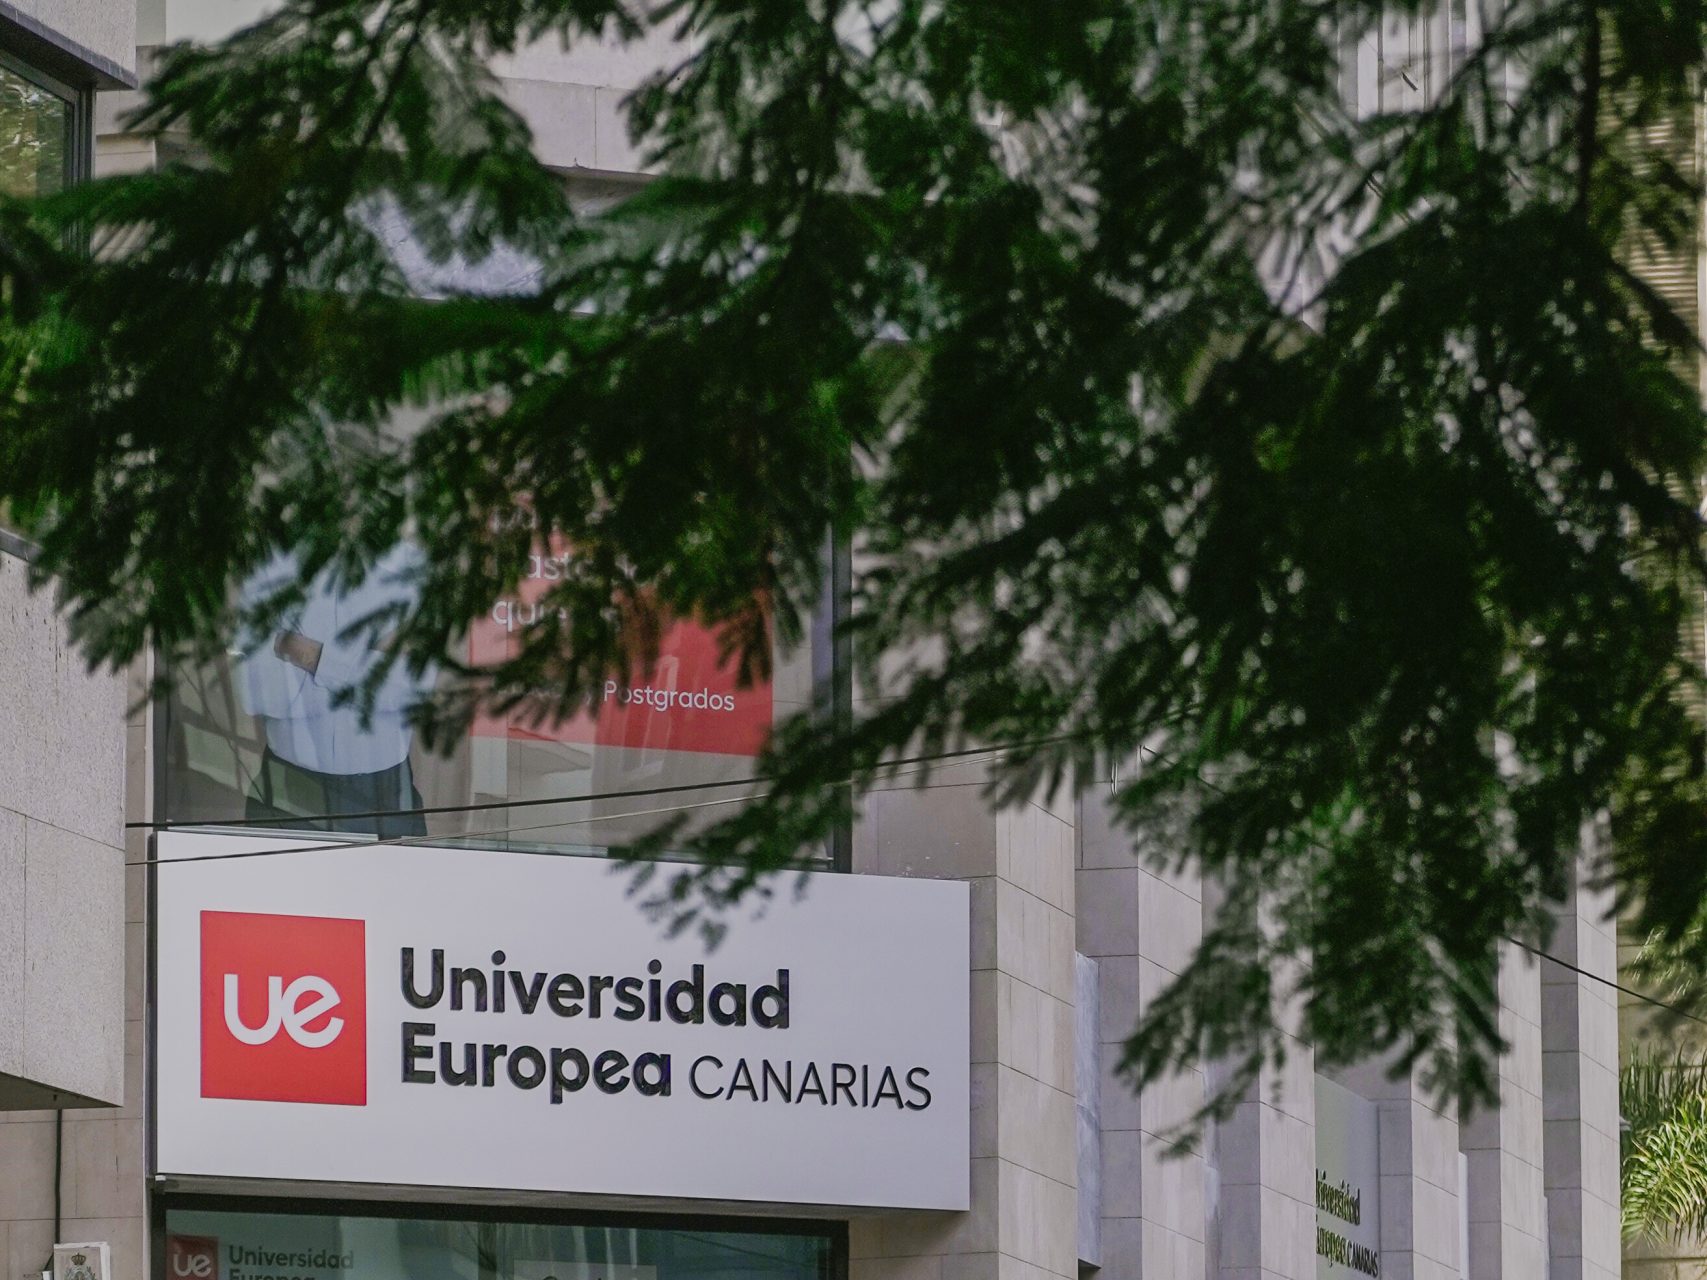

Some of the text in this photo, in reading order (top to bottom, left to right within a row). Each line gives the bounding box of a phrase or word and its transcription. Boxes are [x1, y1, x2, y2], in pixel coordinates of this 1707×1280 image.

[603, 680, 735, 712] Postgrados
[223, 973, 345, 1050] ue
[400, 947, 790, 1030] Universidad
[401, 1021, 931, 1111] Europea CANARIAS
[174, 1253, 212, 1278] ue
[229, 1245, 355, 1270] Universidad
